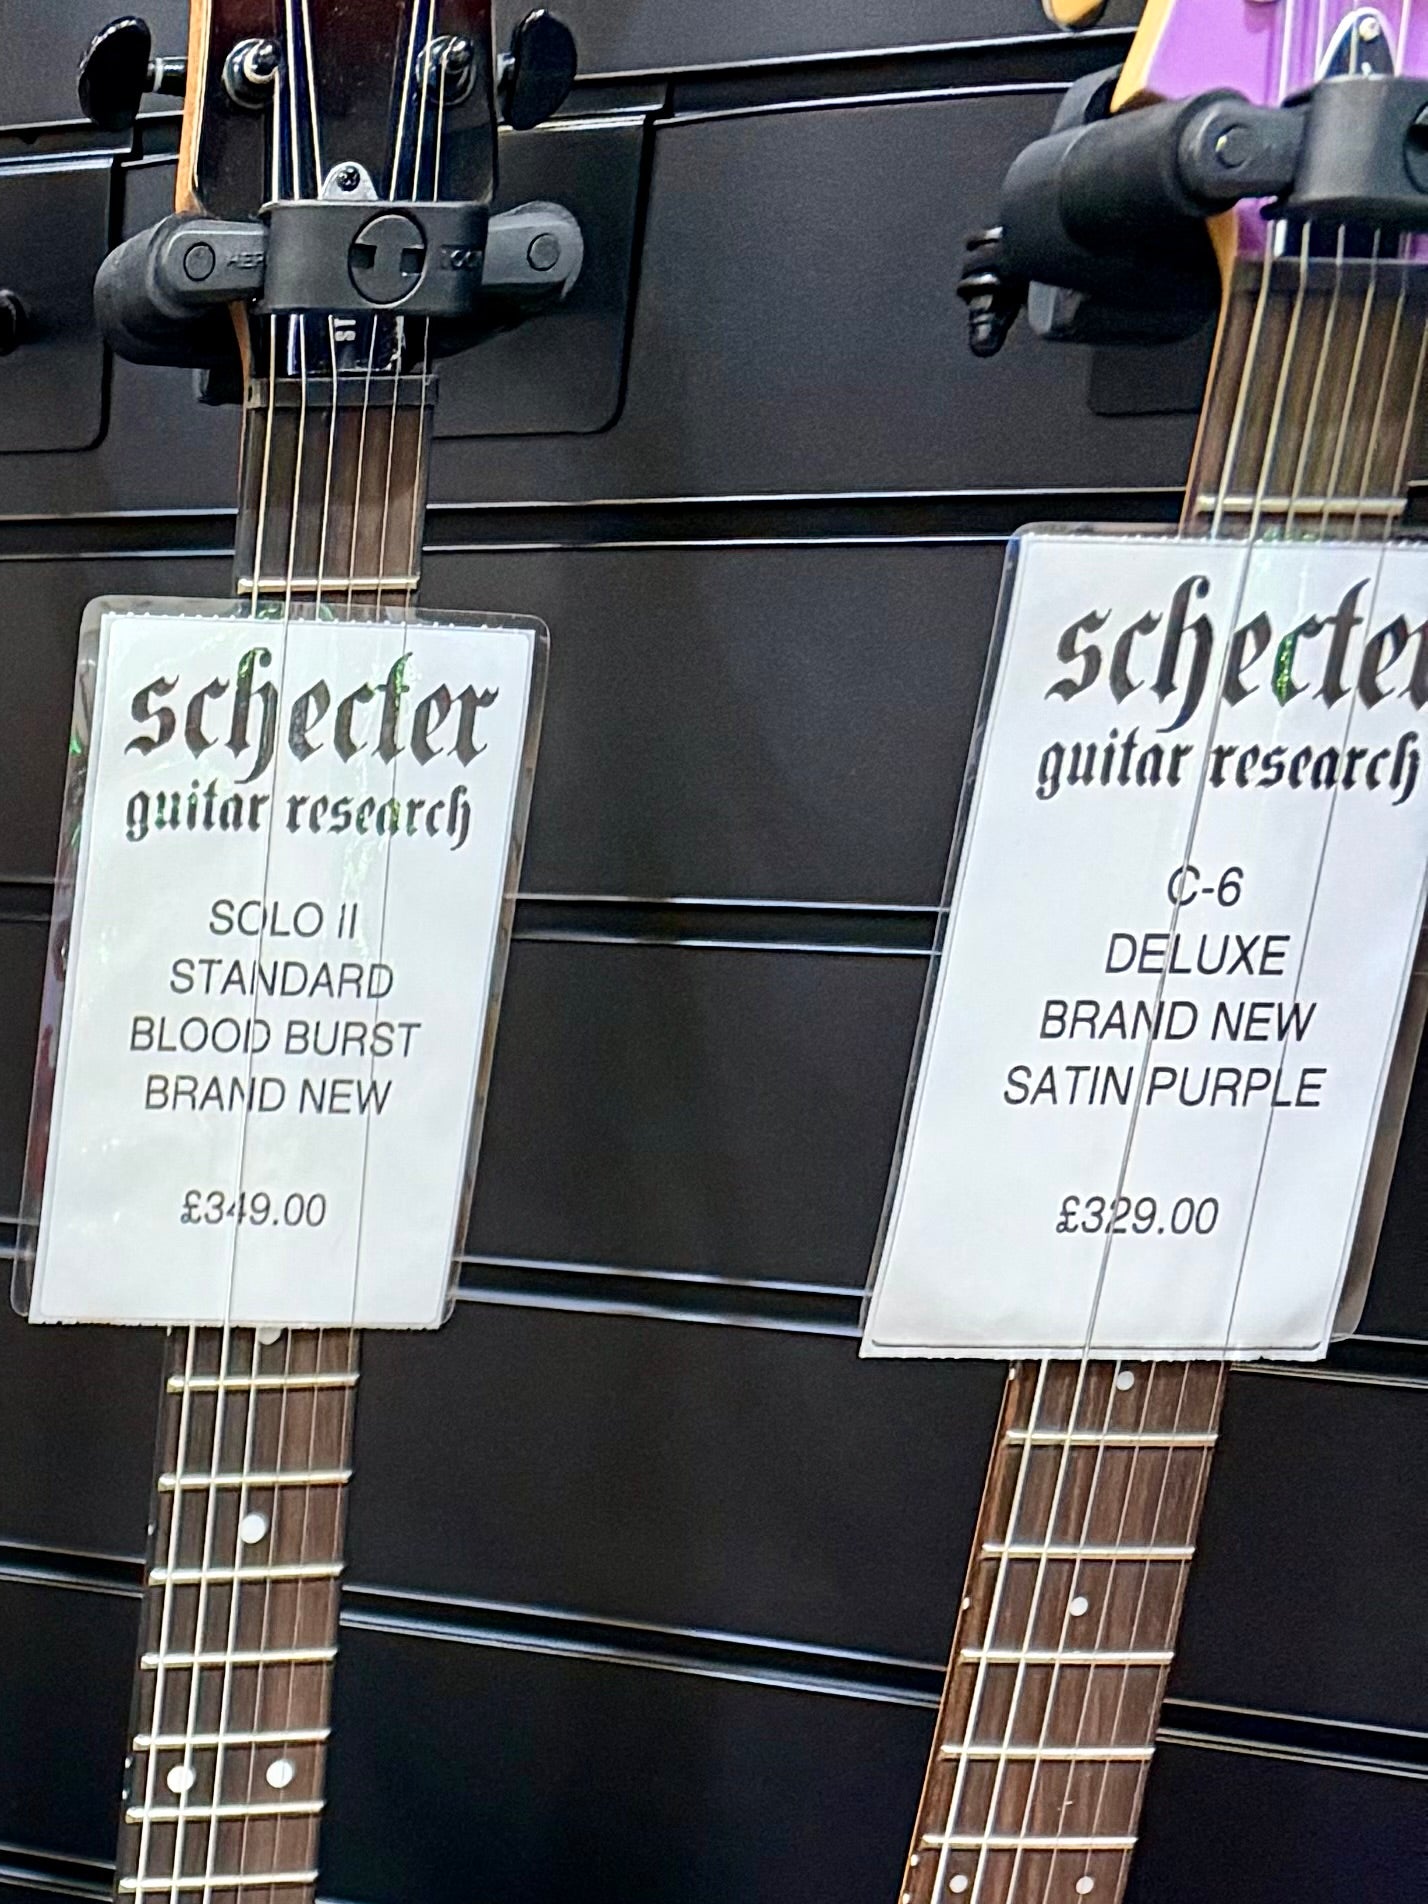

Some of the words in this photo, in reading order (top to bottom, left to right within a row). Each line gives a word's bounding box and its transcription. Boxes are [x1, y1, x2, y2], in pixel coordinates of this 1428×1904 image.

[125, 646, 500, 784] schecter
[1036, 727, 1191, 799] guitar
[1209, 732, 1420, 806] research
[126, 779, 268, 841] guitar
[285, 784, 472, 850] research
[1166, 864, 1243, 908] C-6
[209, 898, 323, 939] SOLO
[1106, 933, 1291, 976] DELUXE
[170, 957, 394, 1000] STANDARD
[130, 1016, 270, 1054] BLOOD
[285, 1020, 422, 1058] BURST
[1040, 1000, 1199, 1041] BRAND
[1211, 1001, 1316, 1043] NEW
[145, 1073, 286, 1114] BRAND
[299, 1078, 393, 1115] NEW
[1003, 1064, 1134, 1107] SATIN
[1145, 1065, 1328, 1109] PURPLE
[180, 1190, 327, 1228] £349.00
[1056, 1194, 1220, 1236] £329.00
